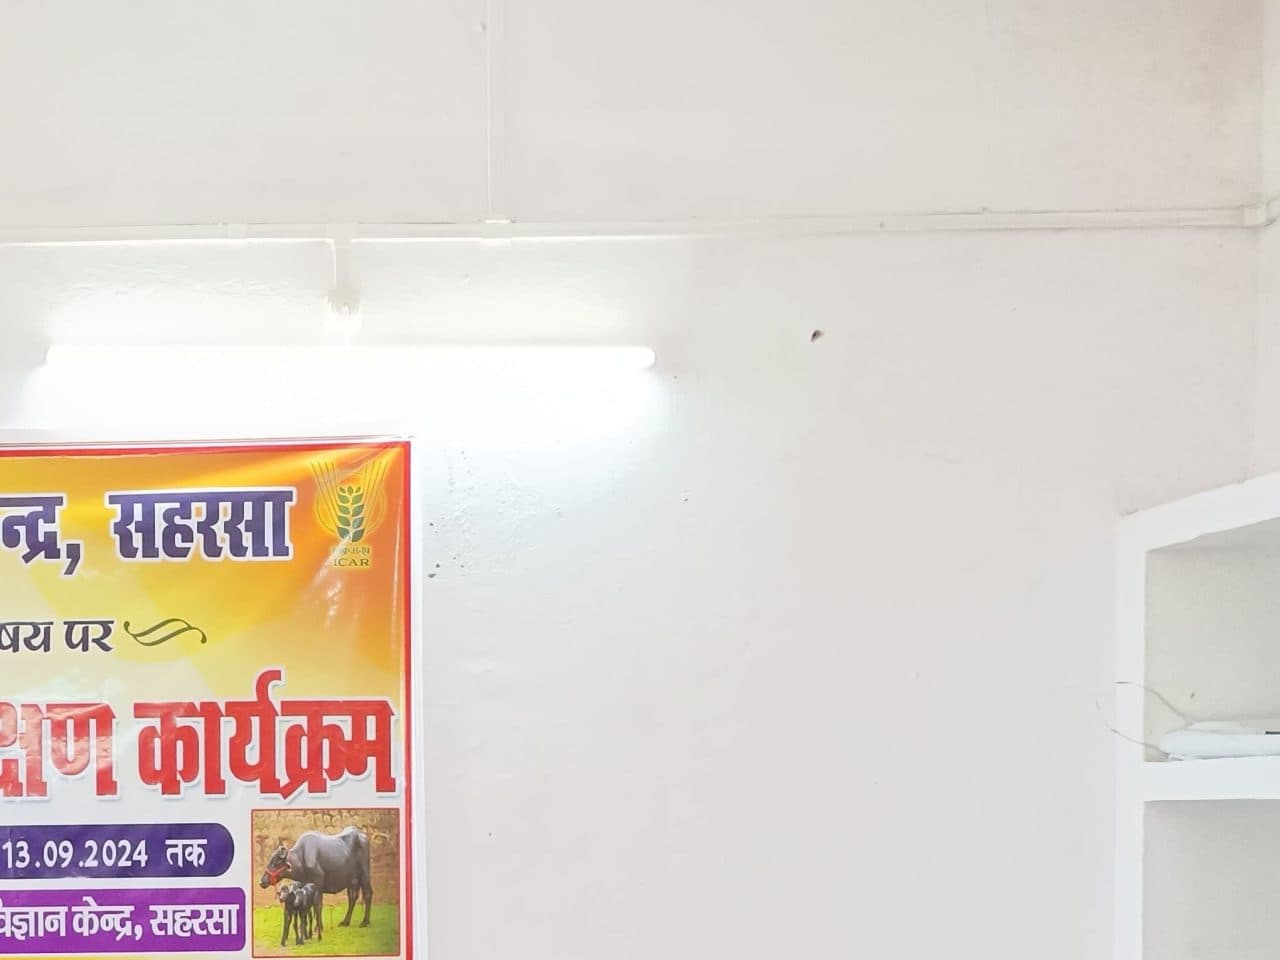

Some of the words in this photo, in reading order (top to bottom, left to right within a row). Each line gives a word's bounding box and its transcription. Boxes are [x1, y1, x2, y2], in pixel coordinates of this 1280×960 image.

[108, 490, 294, 559] सहरसा
[64, 620, 115, 652] पर
[134, 669, 397, 800] कार्यक्रम
[2, 840, 148, 868] 13.09.2024
[165, 839, 208, 868] तक
[149, 904, 240, 938] सहरसा
